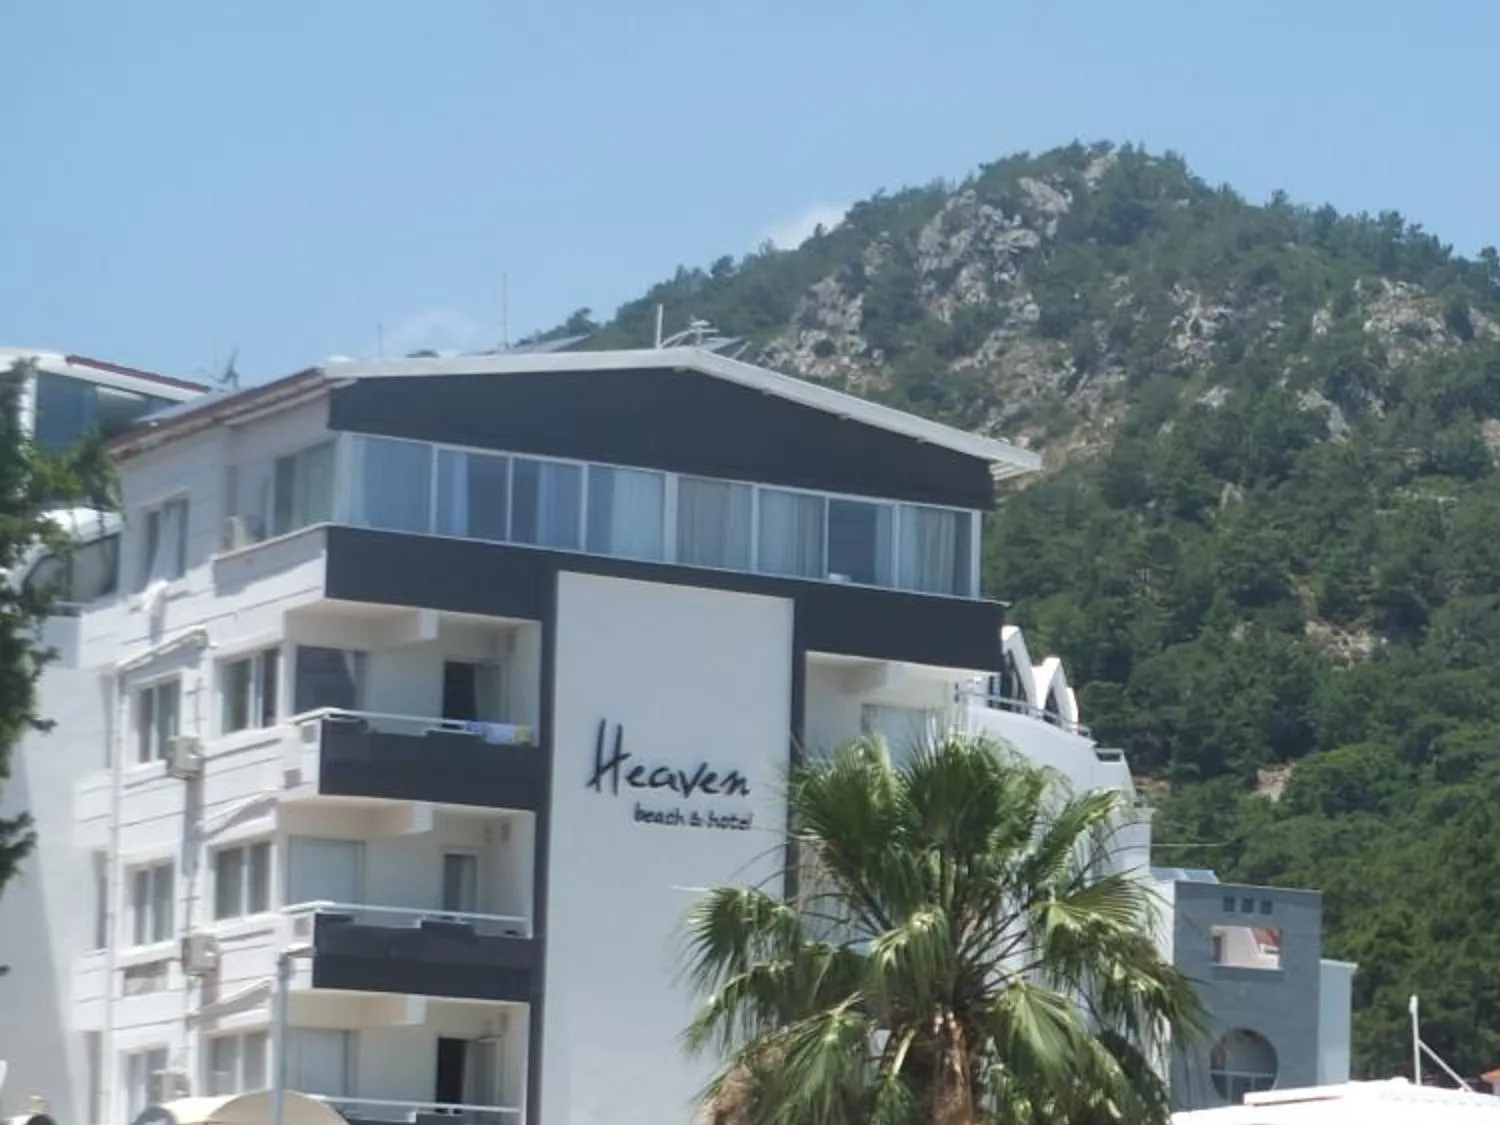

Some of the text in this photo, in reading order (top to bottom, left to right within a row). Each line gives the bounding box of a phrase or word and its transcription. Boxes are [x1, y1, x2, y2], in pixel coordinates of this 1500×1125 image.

[586, 717, 752, 798] Heaven
[633, 801, 684, 826] beach
[707, 808, 753, 831] hotel
